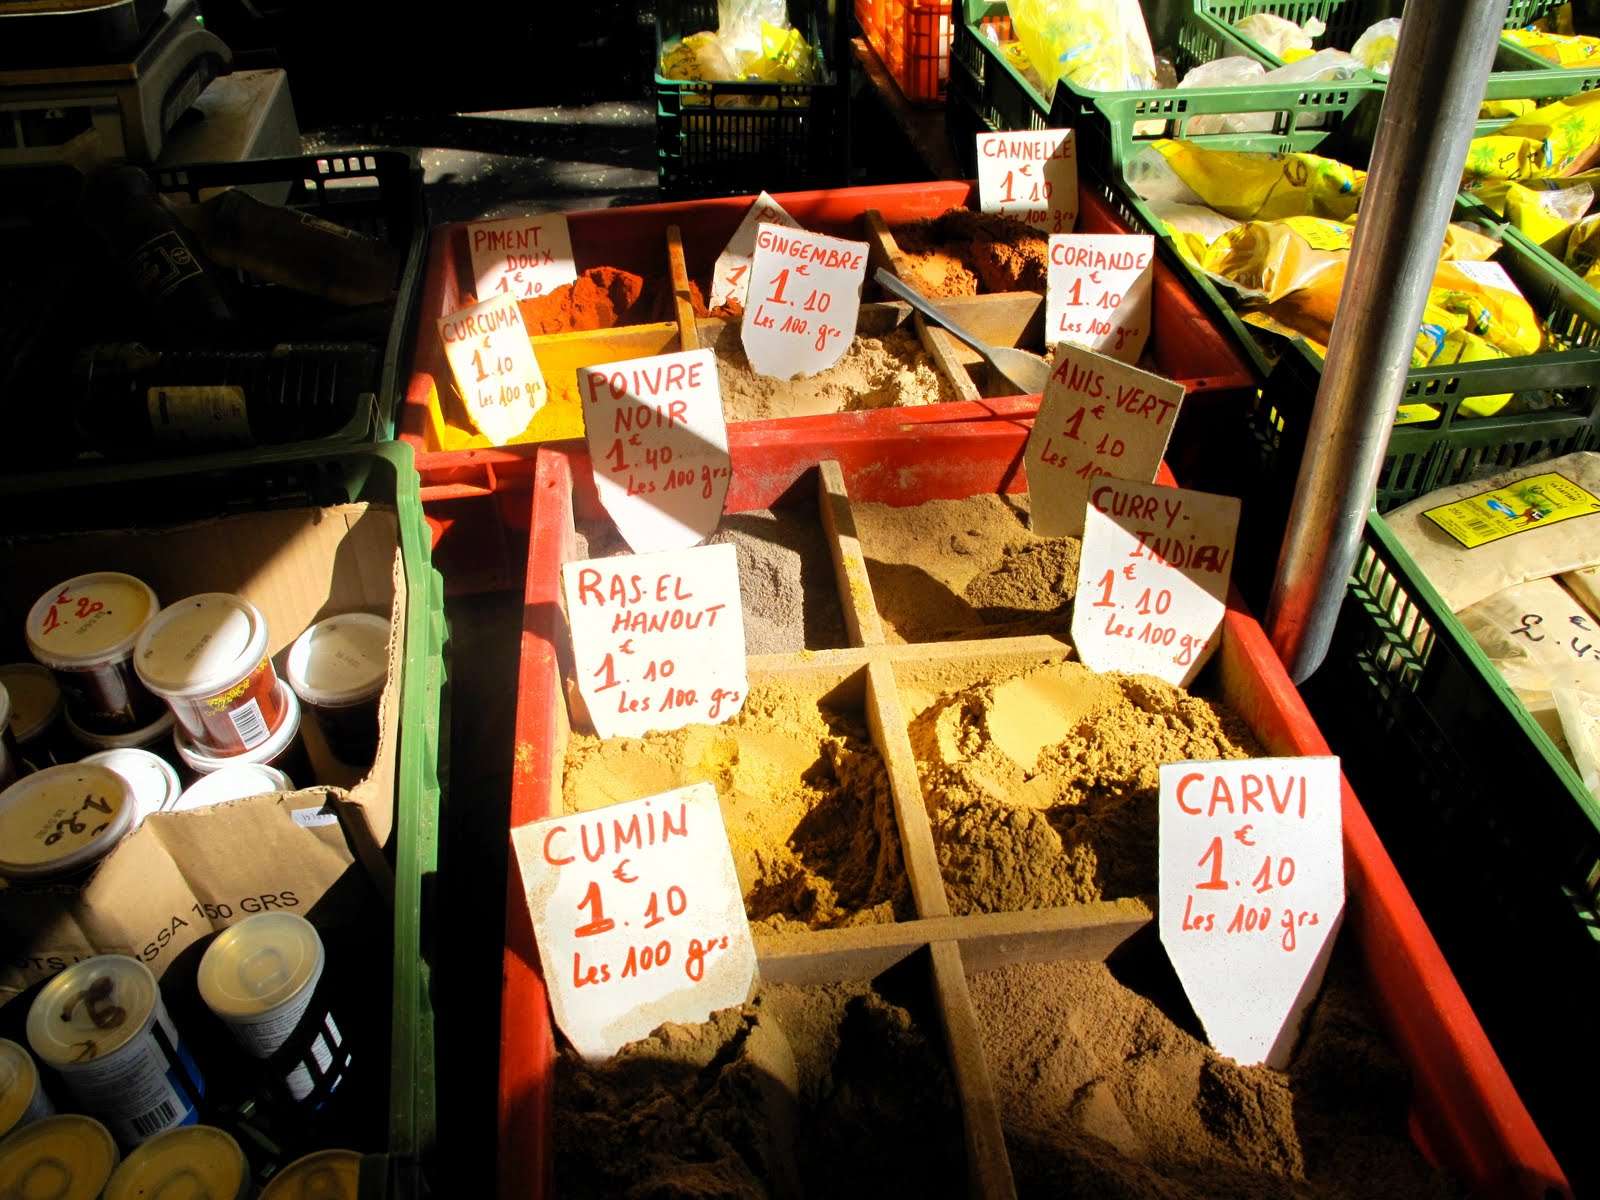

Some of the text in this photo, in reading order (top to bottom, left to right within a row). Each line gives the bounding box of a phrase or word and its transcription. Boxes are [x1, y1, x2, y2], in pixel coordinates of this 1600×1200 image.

[983, 138, 1073, 161] CANNELLE
[1053, 209, 1074, 233] grs
[473, 226, 542, 253] PIMENT
[757, 231, 863, 271] GINGEMBRE
[504, 248, 555, 274] DOUX
[442, 305, 520, 344] CURCUMA
[753, 304, 774, 329] Les
[814, 323, 841, 352] grs
[1059, 313, 1139, 349] Les 100 grs
[478, 381, 541, 409] Les 100 grs
[587, 362, 703, 403] POIVRE
[614, 400, 688, 433] NOIR
[1040, 438, 1068, 469] Les
[626, 465, 728, 499] Les 100 grs
[612, 604, 726, 633] HANOUT
[1104, 613, 1210, 667] Les 100 grs
[618, 691, 650, 713] Les
[708, 688, 740, 719] grs
[1176, 773, 1306, 819] CARVI
[192, 903, 233, 919] 150
[240, 891, 300, 913] GRS
[1182, 895, 1319, 952] Les 100 grs
[573, 936, 729, 988] Les 100 grs
